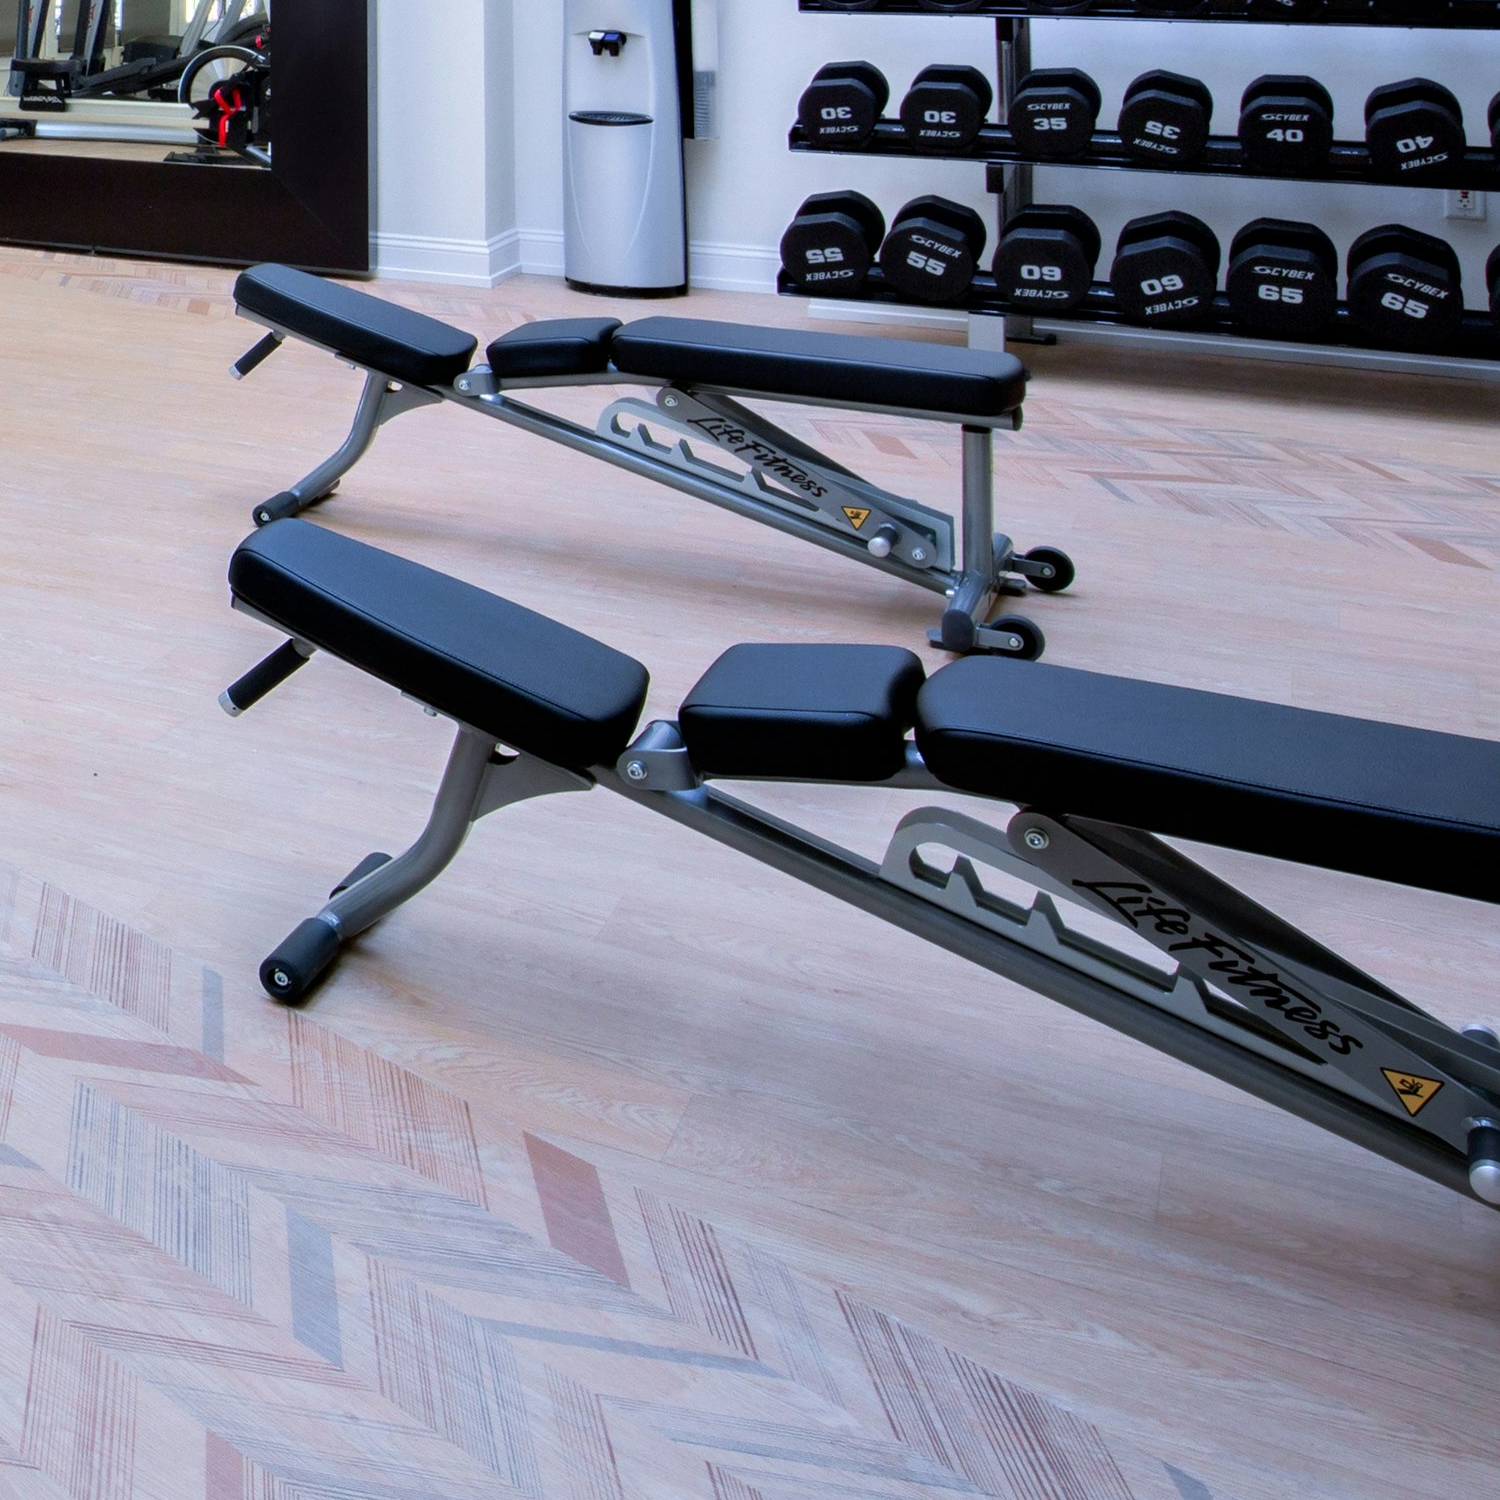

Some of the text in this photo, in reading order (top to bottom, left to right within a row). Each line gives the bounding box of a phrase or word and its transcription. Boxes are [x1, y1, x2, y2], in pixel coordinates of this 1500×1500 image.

[820, 107, 852, 120] 30
[1039, 103, 1071, 111] CYBEX
[923, 110, 957, 124] 30
[1033, 117, 1068, 131] 35
[1275, 114, 1310, 122] CYBEX
[1144, 120, 1182, 140] 35
[1266, 129, 1304, 143] 40
[1396, 135, 1435, 153] 40
[805, 247, 845, 264] 55
[924, 239, 963, 259] CYBEX
[906, 251, 947, 276] 55
[805, 270, 839, 282] CYBEX
[1020, 264, 1062, 282] 60
[1271, 267, 1315, 281] CYBEX
[1014, 288, 1051, 299] CYBEX
[1140, 274, 1184, 296] 60
[1403, 279, 1449, 300] CYBEX
[1258, 284, 1304, 304] 65
[1145, 300, 1183, 316] CYBEX
[1381, 291, 1430, 319] 65
[686, 417, 828, 498] Life Fitness
[1071, 878, 1364, 1055] Life Fitness
